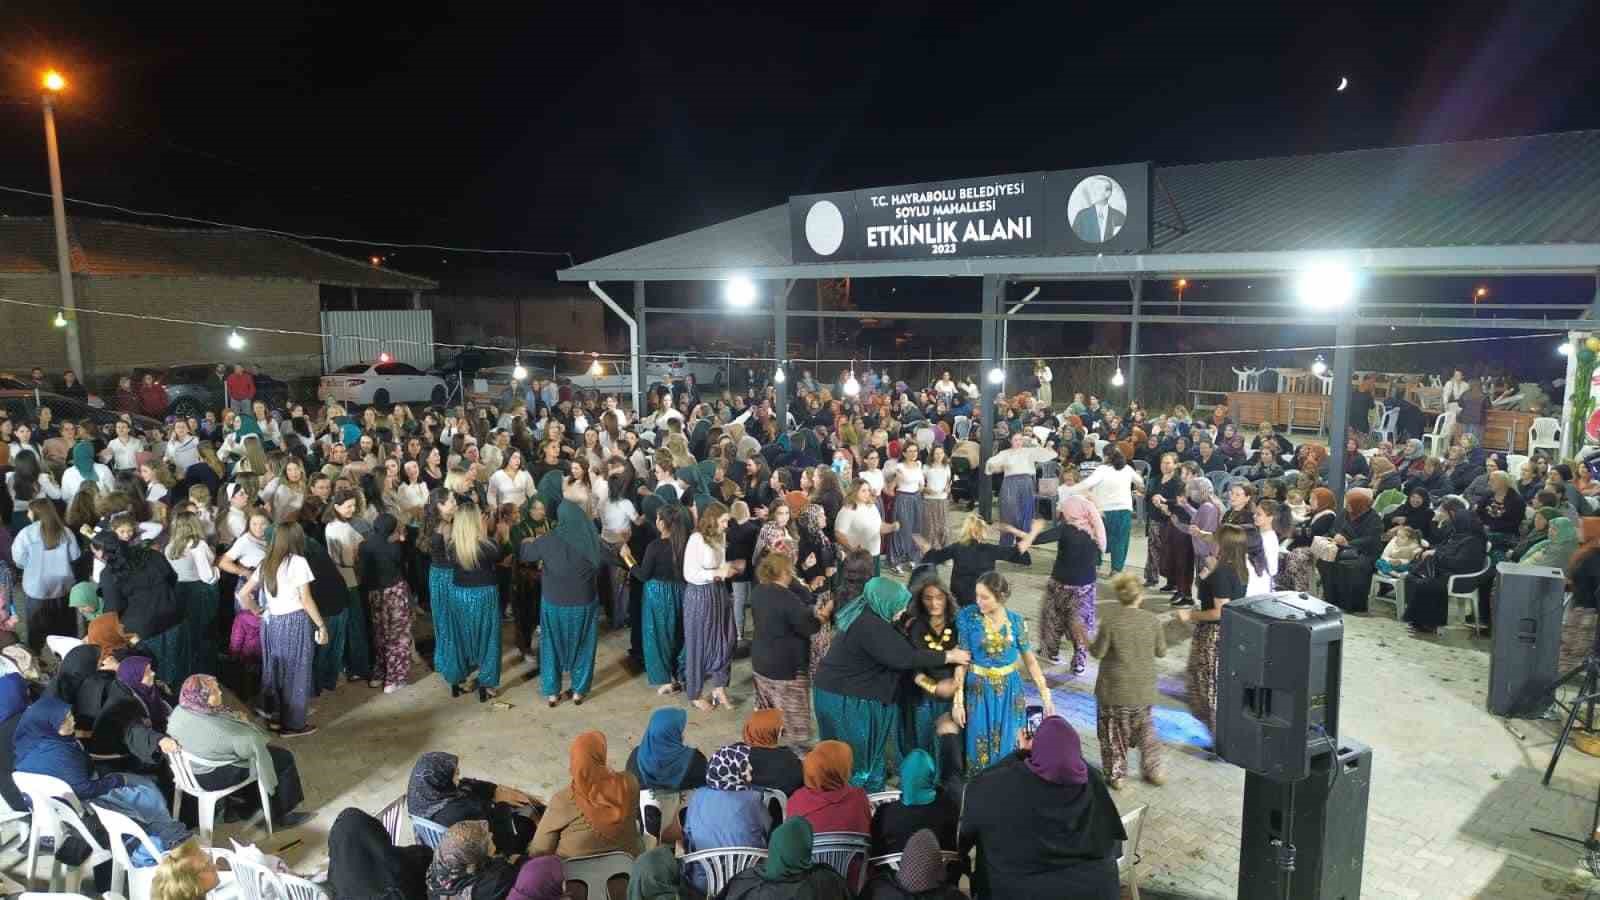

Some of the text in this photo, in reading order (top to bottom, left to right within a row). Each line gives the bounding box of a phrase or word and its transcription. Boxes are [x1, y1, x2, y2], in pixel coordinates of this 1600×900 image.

[871, 182, 1025, 208] T.C. HAYRABOLU BELEDİYESİ
[895, 200, 996, 219] SOYLU MAHALLESİ
[867, 216, 1032, 248] ETKİNLİK ALANI
[931, 244, 957, 255] 2023
